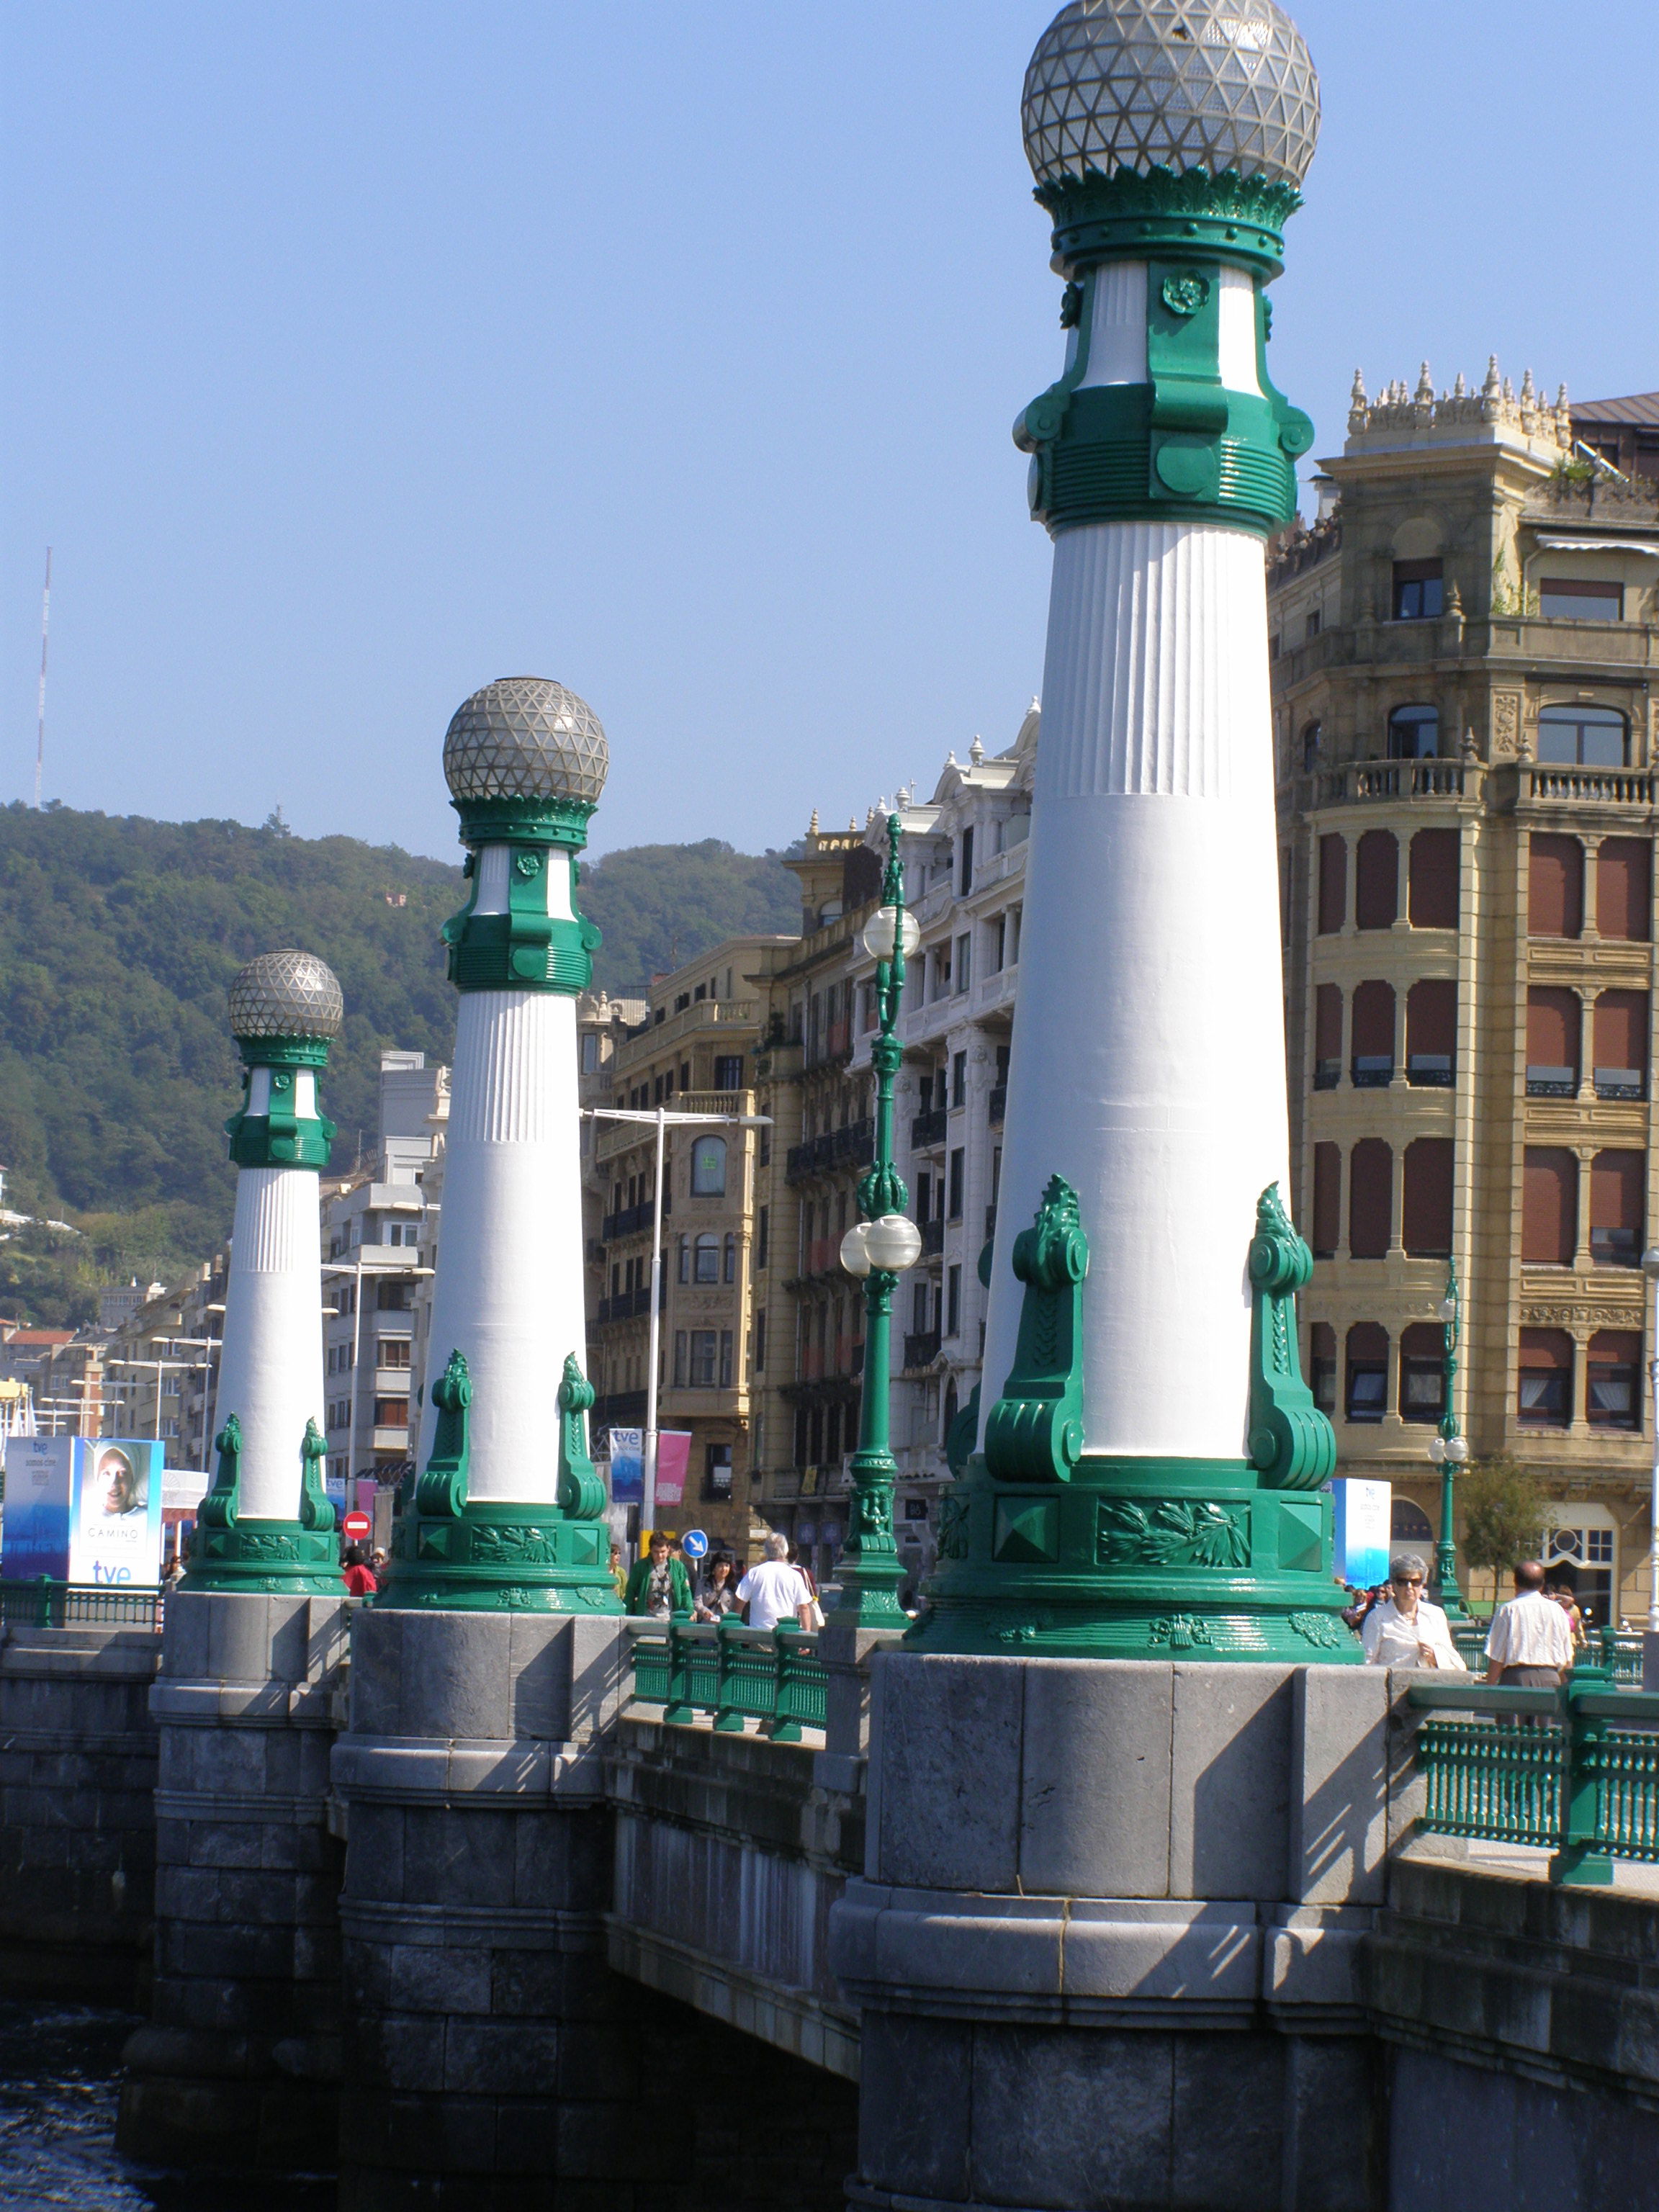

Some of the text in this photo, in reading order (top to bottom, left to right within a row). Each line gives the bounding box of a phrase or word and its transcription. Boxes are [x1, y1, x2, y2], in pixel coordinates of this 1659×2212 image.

[613, 1430, 639, 1445] tve
[33, 1441, 48, 1455] tve
[88, 1527, 138, 1539] CAMINO
[93, 1560, 132, 1584] tve
